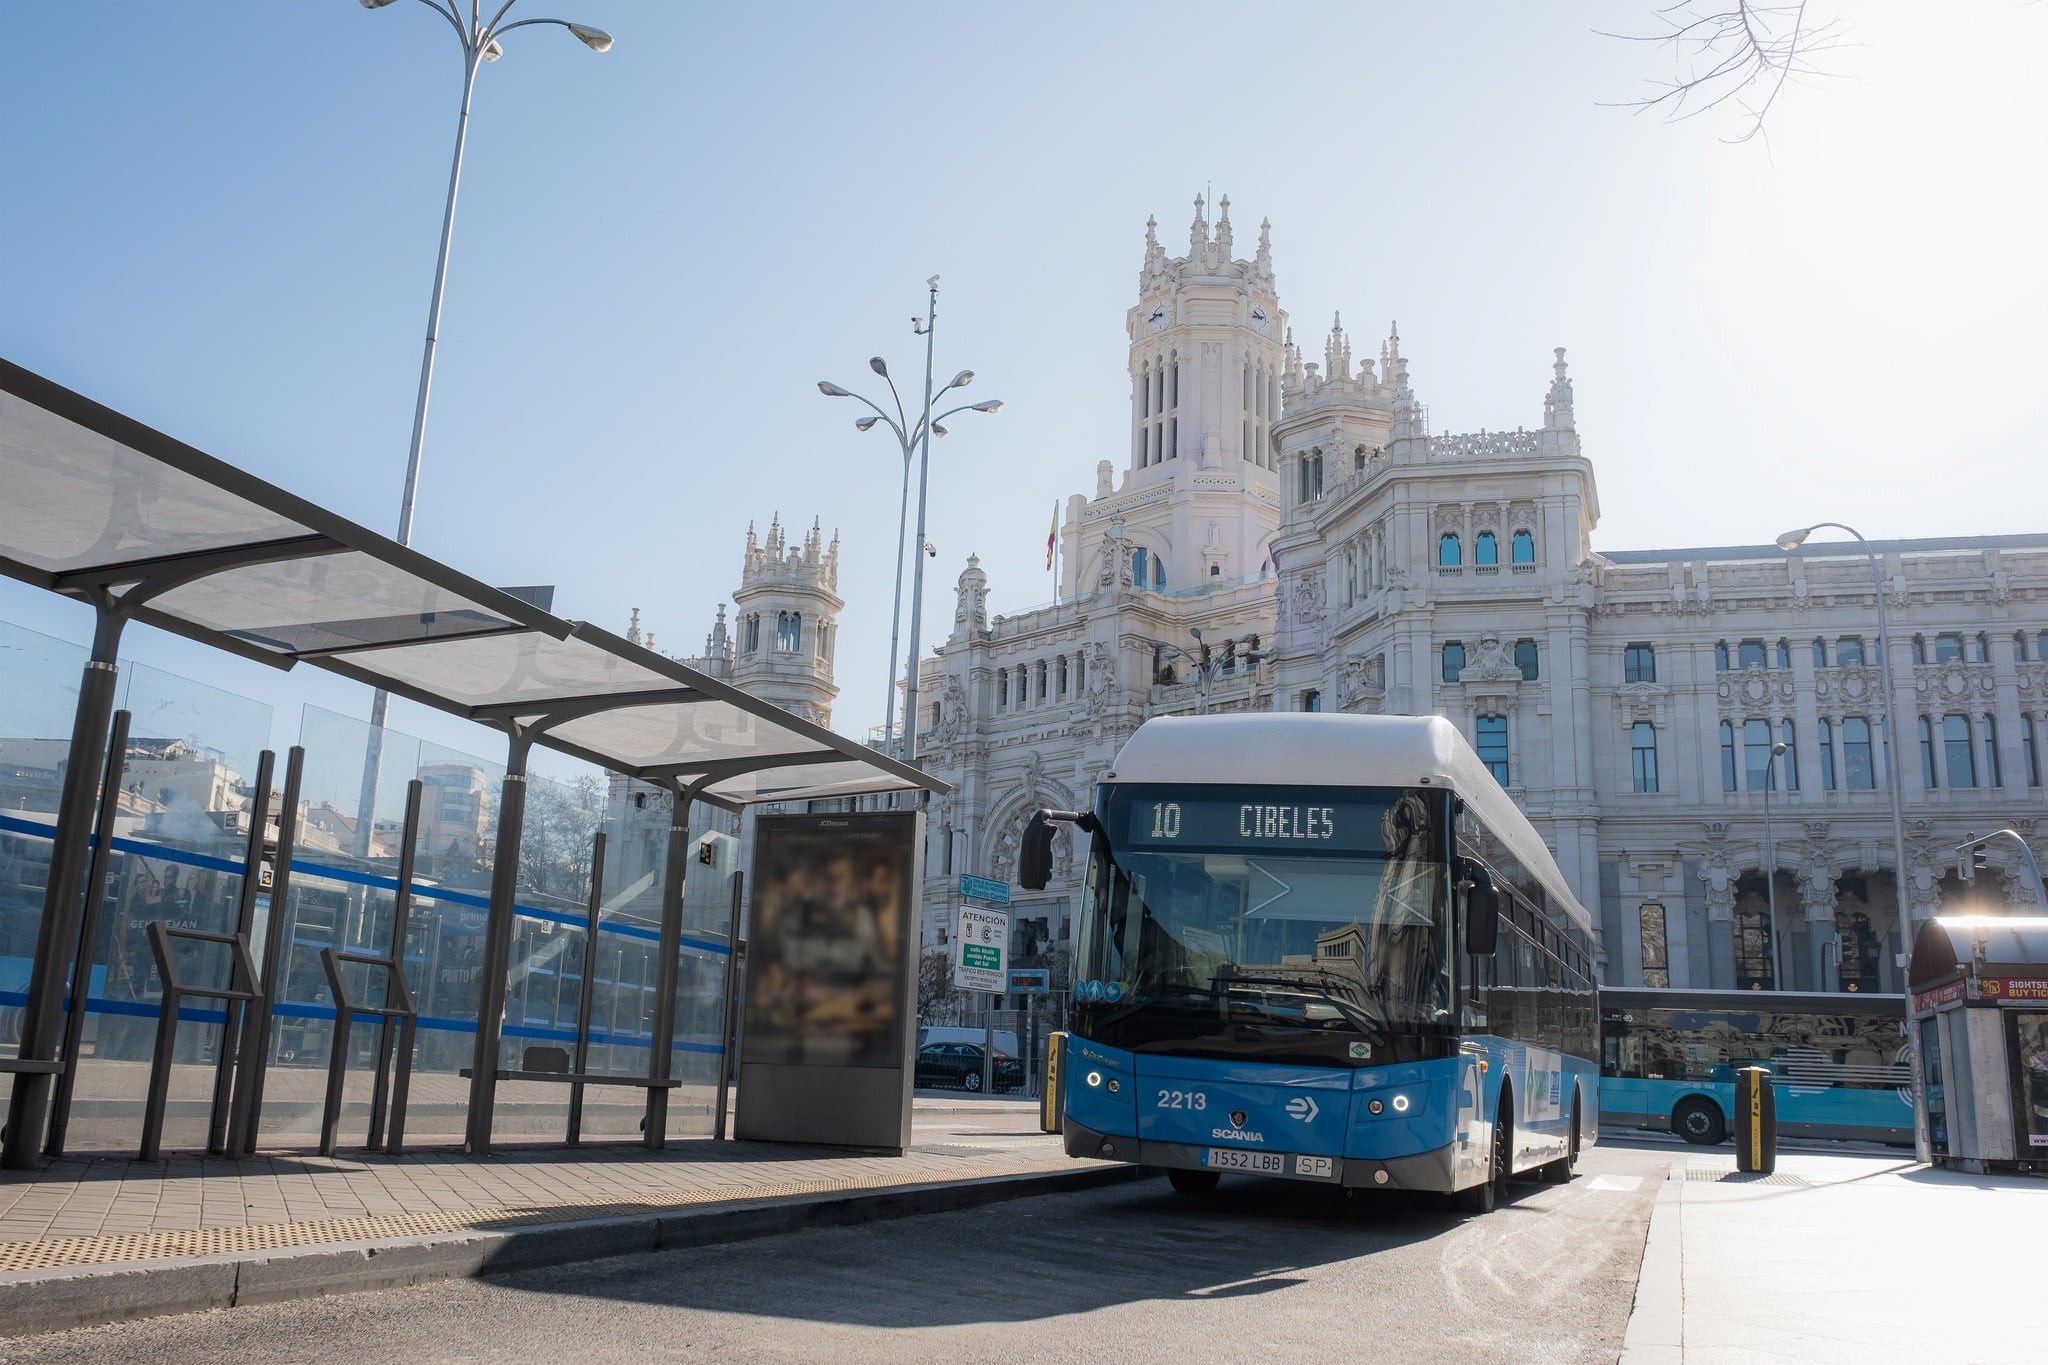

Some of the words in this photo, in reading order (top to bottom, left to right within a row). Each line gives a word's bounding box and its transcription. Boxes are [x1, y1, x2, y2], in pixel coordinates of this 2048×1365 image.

[1152, 803, 1181, 838] 10
[1240, 804, 1334, 839] CIBELES
[131, 920, 197, 929] GENEMAN
[962, 911, 1006, 926] ATENCIÓN
[2009, 989, 2029, 997] BUY
[2031, 989, 2048, 998] TIC
[1157, 1090, 1207, 1111] 2213
[1212, 1128, 1264, 1143] SCANIA
[1213, 1151, 1249, 1168] 1552
[1252, 1155, 1281, 1171] LBB
[1301, 1158, 1328, 1173] SP
